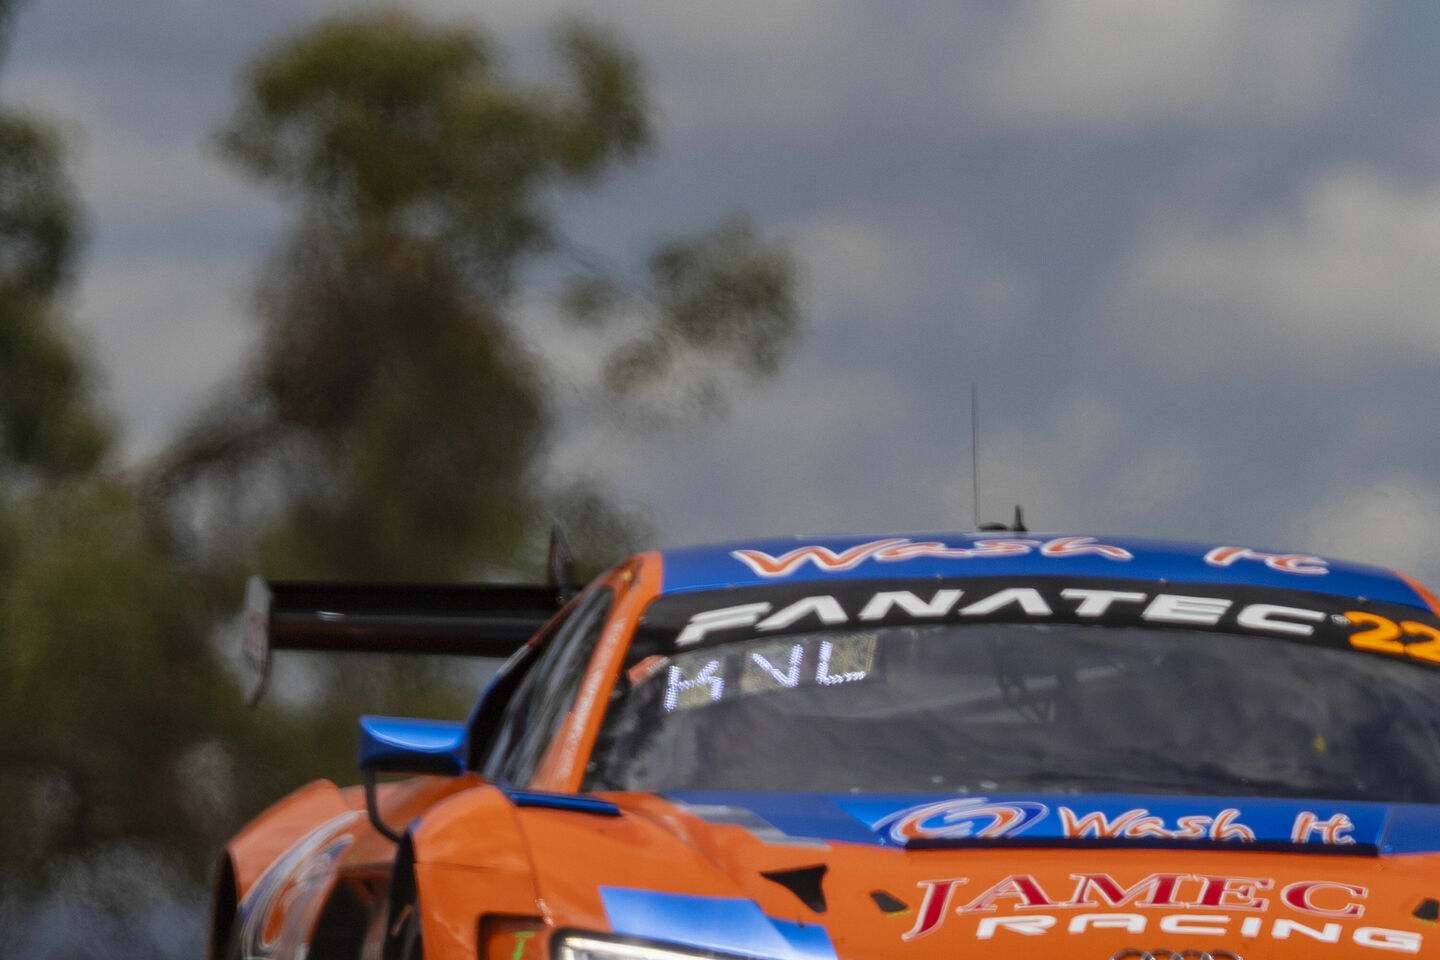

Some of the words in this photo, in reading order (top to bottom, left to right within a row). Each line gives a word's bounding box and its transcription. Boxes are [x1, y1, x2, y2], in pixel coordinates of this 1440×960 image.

[674, 586, 1327, 646] FANATEC
[1058, 805, 1257, 843] Wash
[1290, 811, 1357, 845] It
[901, 873, 1369, 942] JAMEC
[975, 913, 1424, 955] RACING
